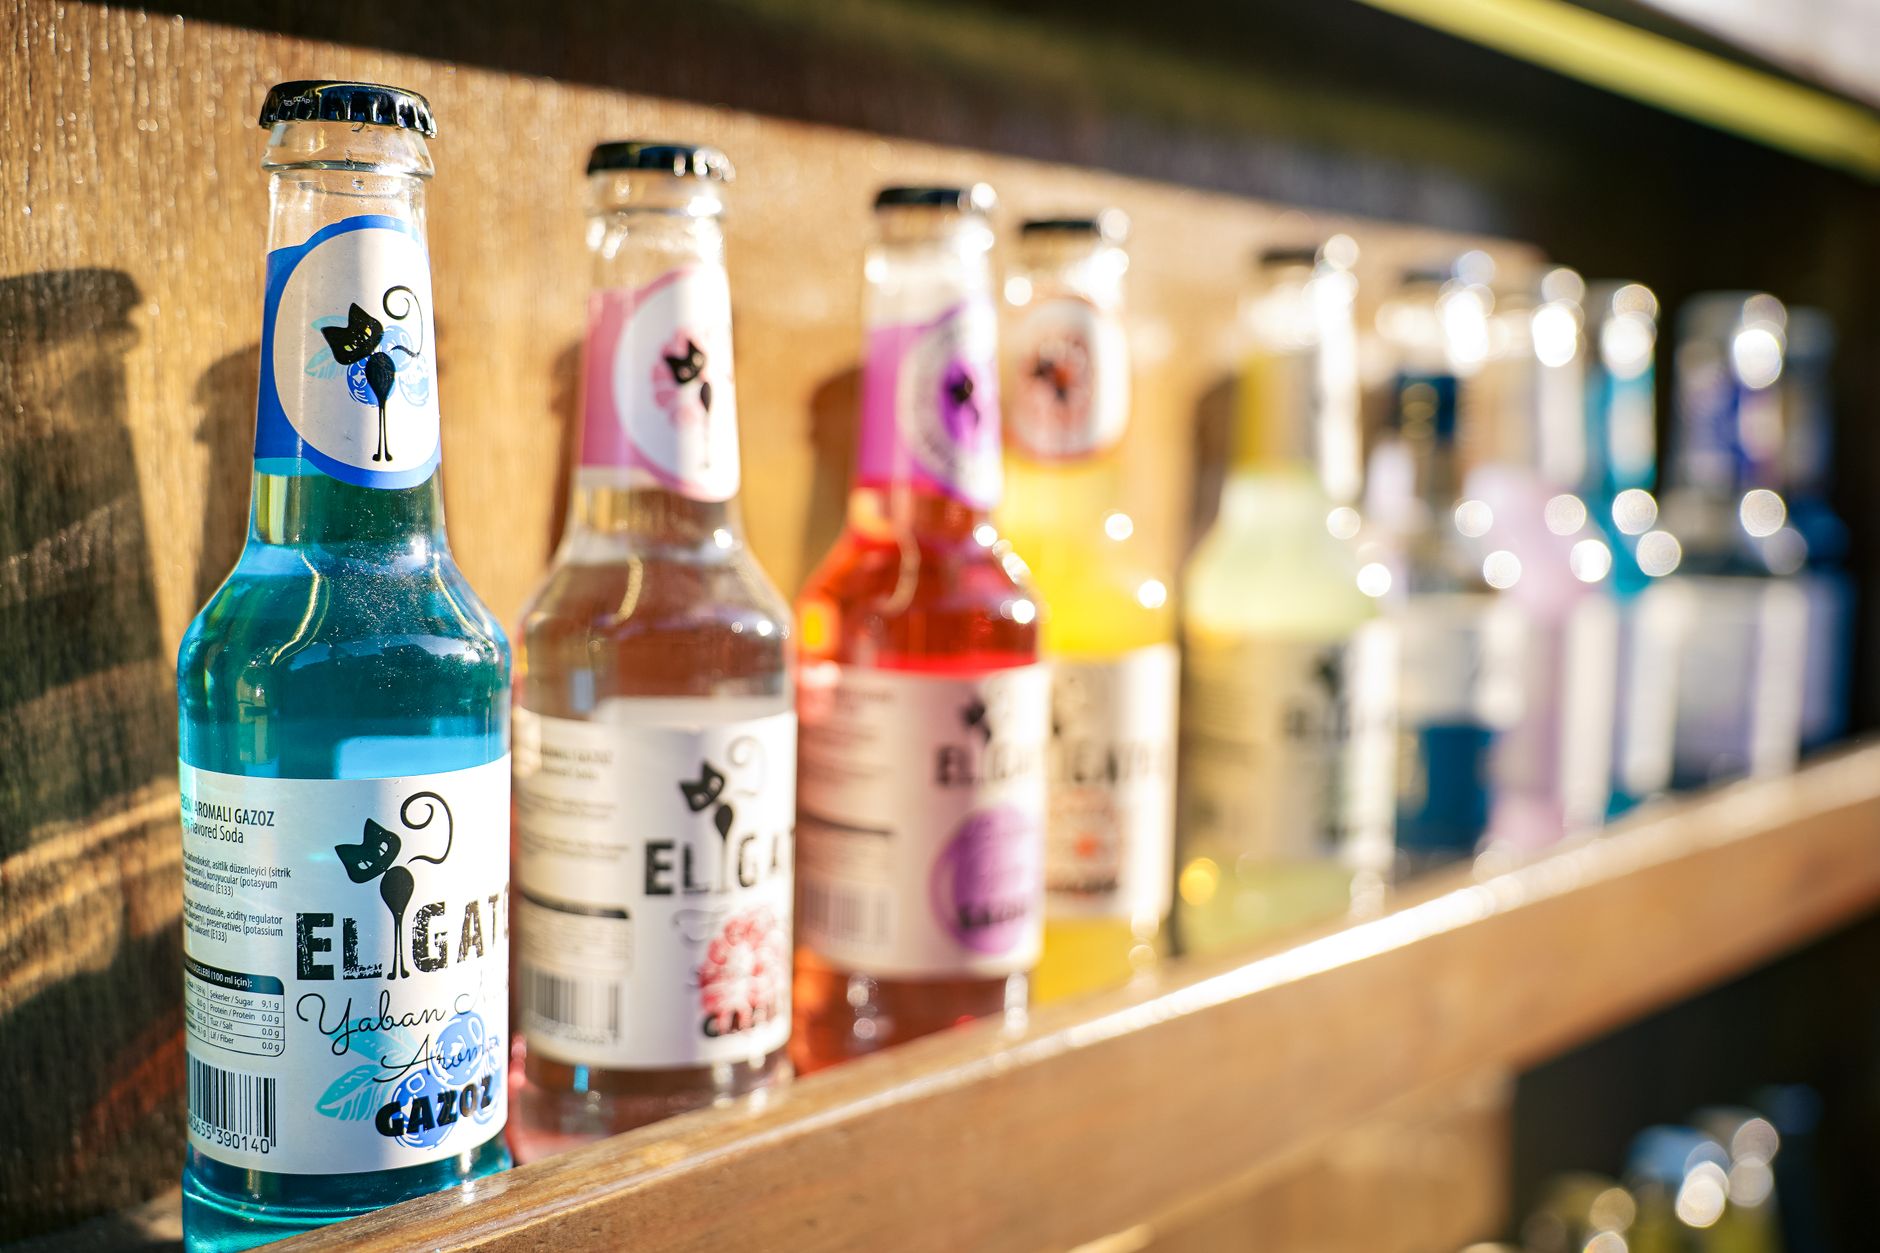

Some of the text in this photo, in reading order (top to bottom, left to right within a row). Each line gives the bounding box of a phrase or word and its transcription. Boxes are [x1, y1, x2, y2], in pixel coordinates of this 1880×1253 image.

[234, 808, 275, 827] GAZOZ
[219, 825, 244, 843] Soda
[229, 862, 267, 878] düzenleyici
[268, 866, 292, 878] (sitrik
[645, 840, 710, 895] EL
[215, 883, 234, 897] (E133)
[239, 876, 278, 890] (potasyum
[206, 917, 242, 933] preservatives
[242, 923, 284, 937] (potassium
[226, 910, 247, 923] acidity
[248, 913, 283, 925] regulator
[210, 929, 228, 943] (E133)
[296, 912, 383, 980] EL
[210, 971, 224, 983] (100
[224, 975, 234, 984] ml
[234, 976, 253, 988] için):
[235, 996, 254, 1008] Sugar
[273, 1002, 280, 1011] g
[209, 1004, 228, 1017] Protein
[232, 1009, 256, 1021] Protein
[261, 1013, 273, 1022] 0.0
[274, 1016, 280, 1025] g
[296, 989, 447, 1056] Yaban
[210, 1017, 218, 1026] Tuz
[222, 1021, 233, 1031] Salt
[261, 1027, 273, 1036] 0.0
[274, 1030, 280, 1039] g
[220, 1033, 234, 1044] Fiber
[261, 1041, 273, 1050] 0.0
[274, 1044, 280, 1053] g
[375, 1073, 493, 1138] GAZOZ
[216, 1128, 270, 1154] 390140
